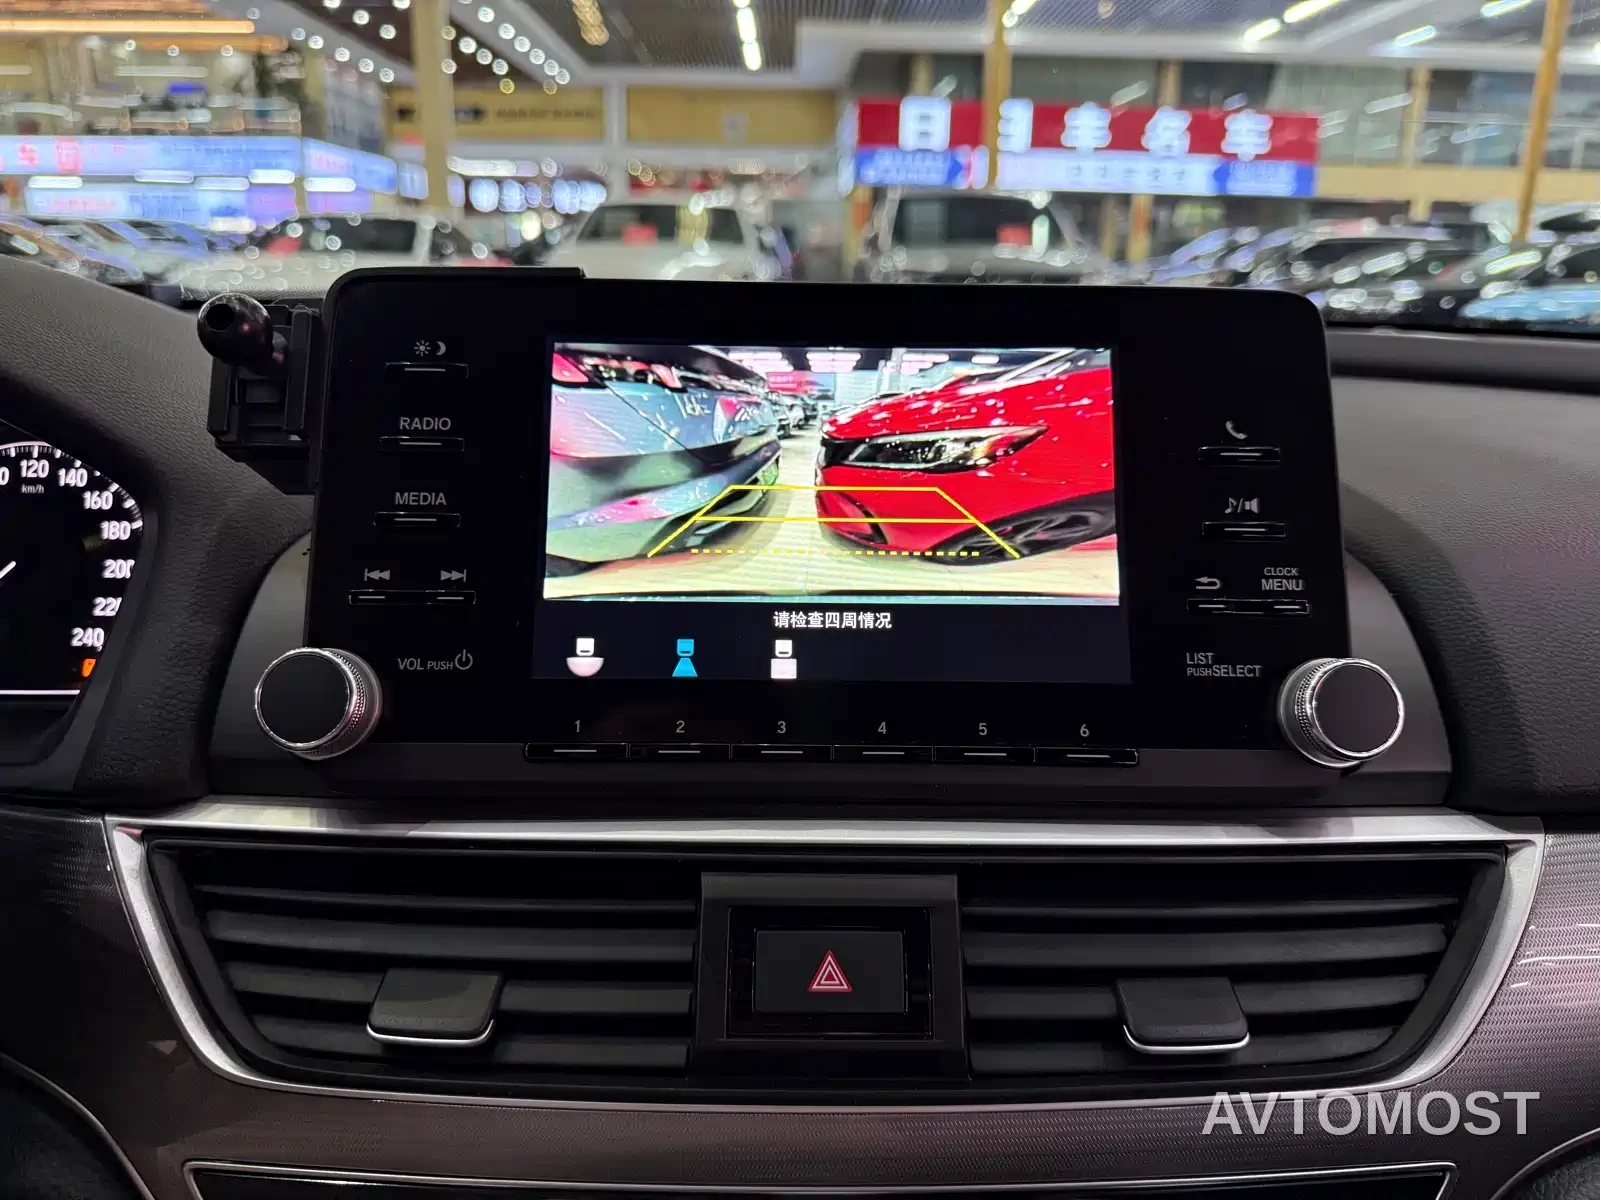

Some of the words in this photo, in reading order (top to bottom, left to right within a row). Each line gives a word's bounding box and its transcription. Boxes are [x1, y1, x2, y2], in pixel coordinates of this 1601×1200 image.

[399, 416, 452, 431] RADIO
[20, 459, 49, 478] 120
[57, 467, 88, 487] 140
[20, 483, 45, 494] km/h
[82, 490, 114, 510] 160
[395, 491, 447, 506] MEDIA
[101, 521, 131, 541] 180
[1263, 566, 1299, 577] CLOCK
[1261, 578, 1304, 591] MENU
[773, 611, 893, 629] 请检查四周情况
[70, 627, 105, 647] 240
[397, 658, 425, 671] VOL
[427, 660, 453, 671] PUSH
[1186, 652, 1214, 665] LIST
[1187, 667, 1212, 677] PUSH
[1212, 664, 1262, 677] SELECT
[573, 719, 581, 733] 1
[675, 720, 686, 733] 2
[777, 720, 787, 734] 3
[877, 721, 887, 735] 4
[978, 722, 988, 736] 5
[1079, 723, 1090, 737] 6
